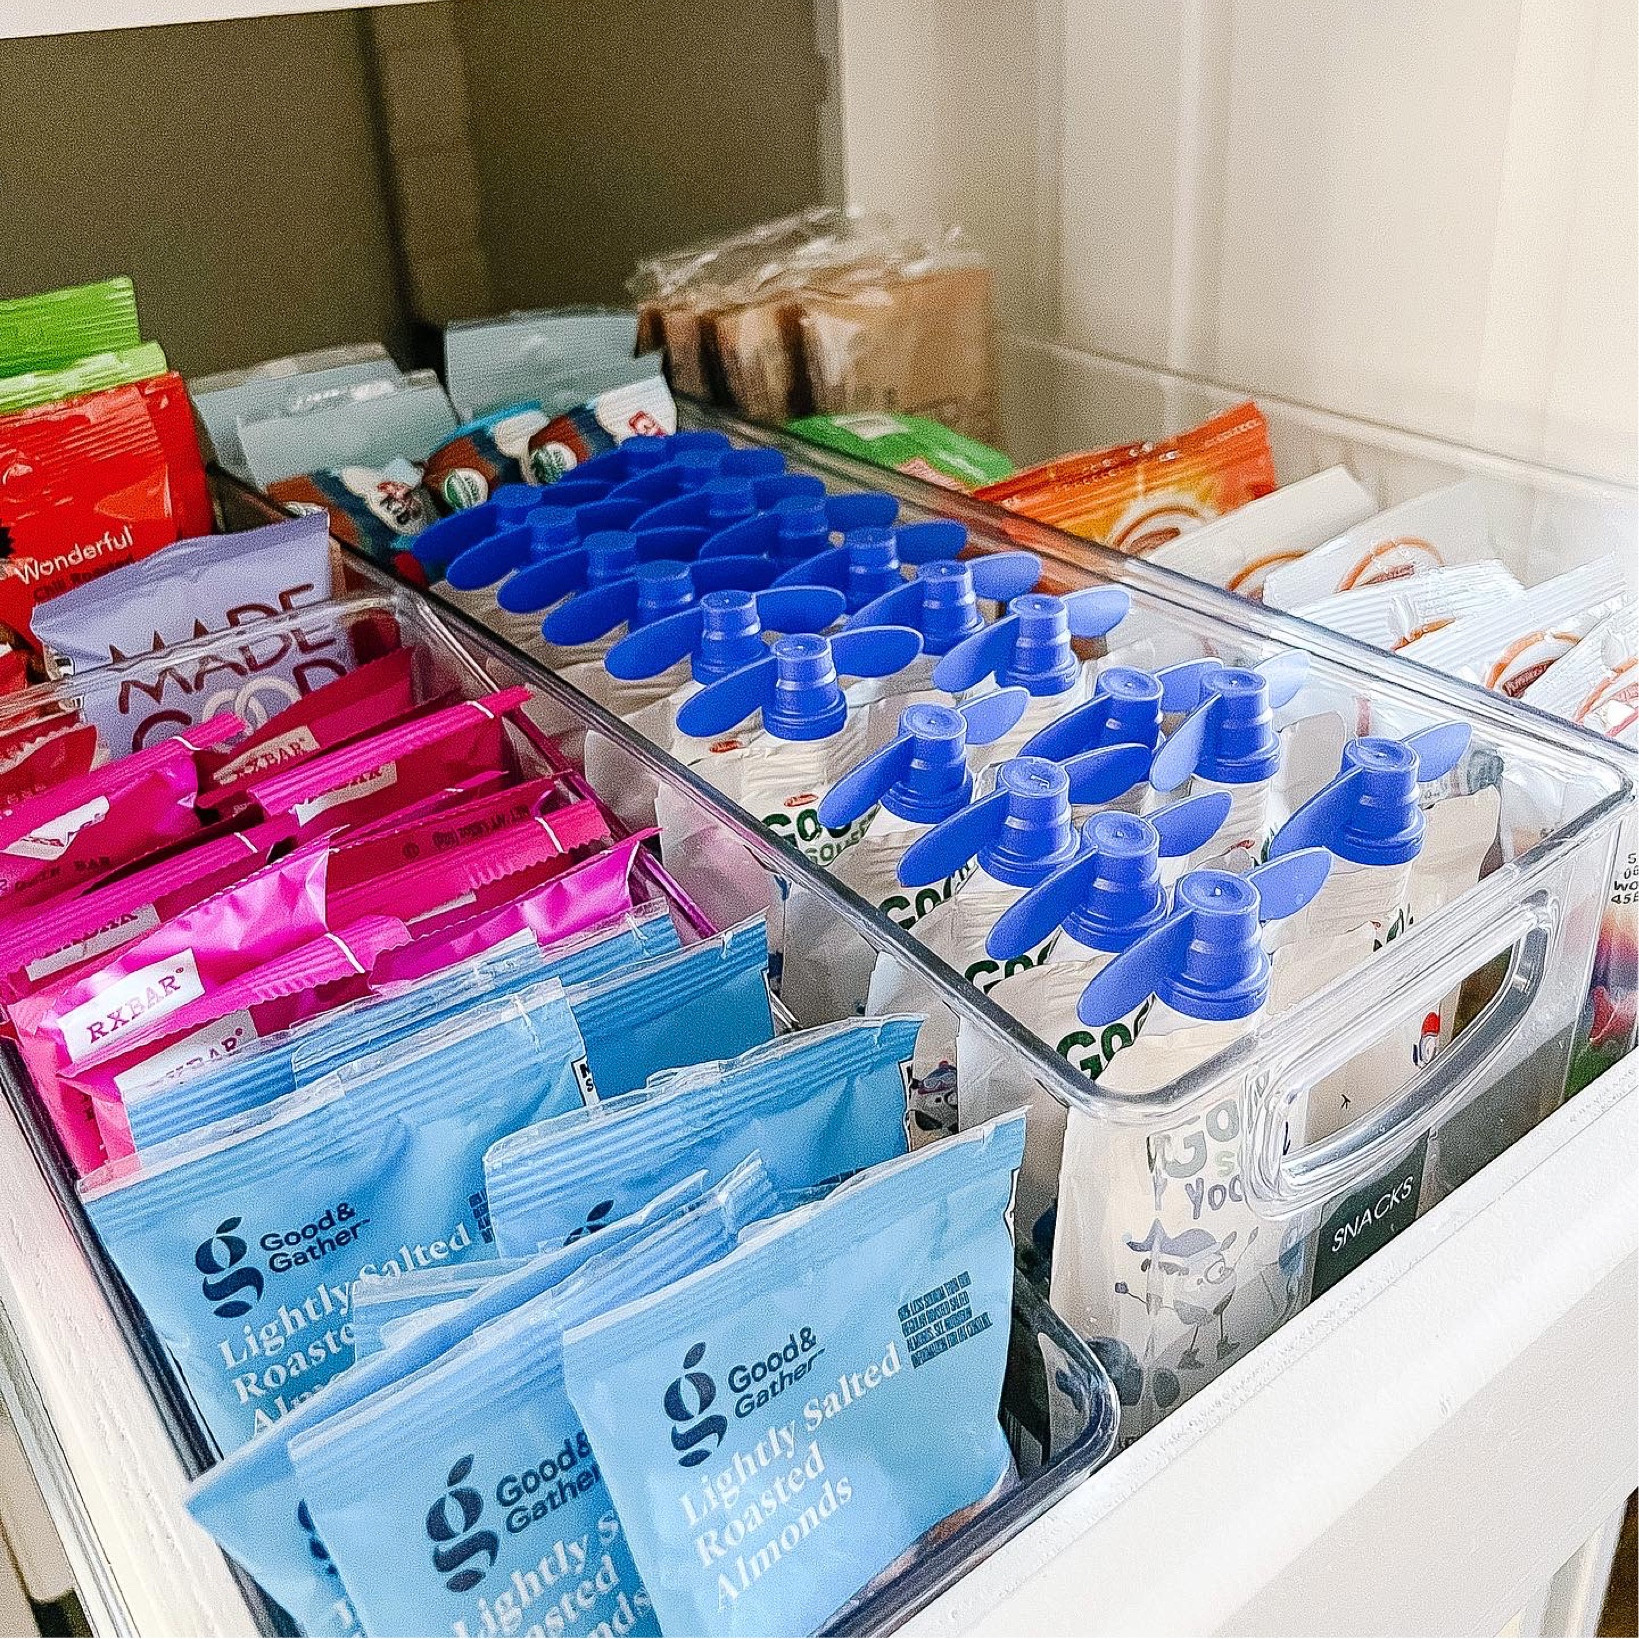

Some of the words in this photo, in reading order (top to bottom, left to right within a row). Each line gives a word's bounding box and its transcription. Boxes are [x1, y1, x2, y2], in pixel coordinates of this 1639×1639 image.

[15, 524, 133, 585] Wonderful
[268, 1225, 362, 1273] Gather
[1332, 1175, 1414, 1252] SNACKS
[218, 1282, 355, 1370] Lightly
[358, 1222, 473, 1286] Salted
[679, 1420, 797, 1526] Lightly
[803, 1340, 902, 1432] Salted
[734, 1356, 819, 1418] Gather
[695, 1441, 826, 1568] Roasted
[716, 1477, 853, 1613] Almonds
